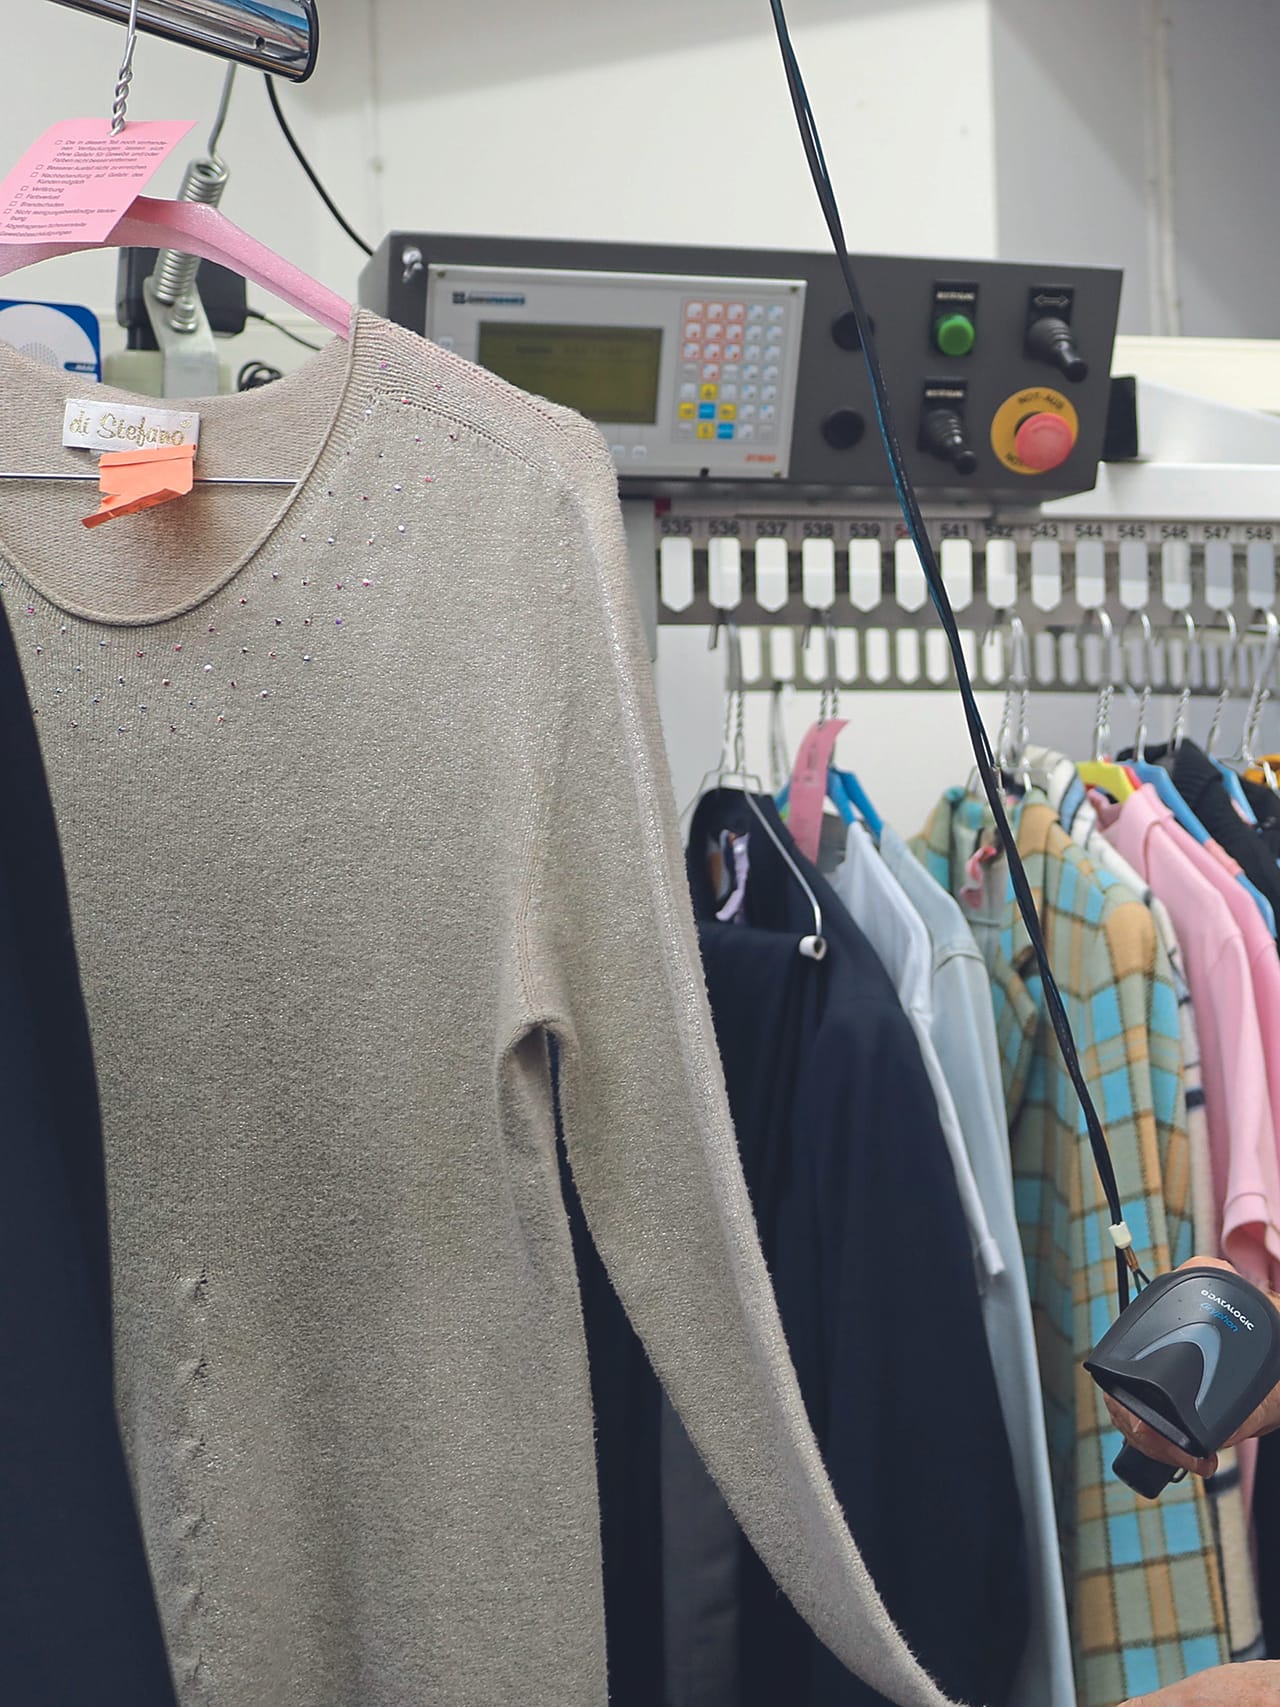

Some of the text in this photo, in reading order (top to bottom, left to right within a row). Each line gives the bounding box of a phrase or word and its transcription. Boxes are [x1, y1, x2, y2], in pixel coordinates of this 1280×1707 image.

[69, 411, 185, 448] di Stefano
[661, 519, 693, 535] 535
[708, 520, 740, 536] 536
[755, 521, 788, 536] 537
[803, 521, 834, 537] 538
[850, 522, 881, 537] 539
[941, 523, 969, 537] 541
[1031, 524, 1059, 538] 543
[1075, 524, 1103, 538] 544
[1118, 524, 1146, 539] 545
[1161, 525, 1189, 539] 546
[1203, 525, 1231, 540] 547
[1246, 526, 1273, 541] 548
[1200, 1302, 1239, 1333] Gryphon
[1206, 1291, 1255, 1331] DATALOGIC
